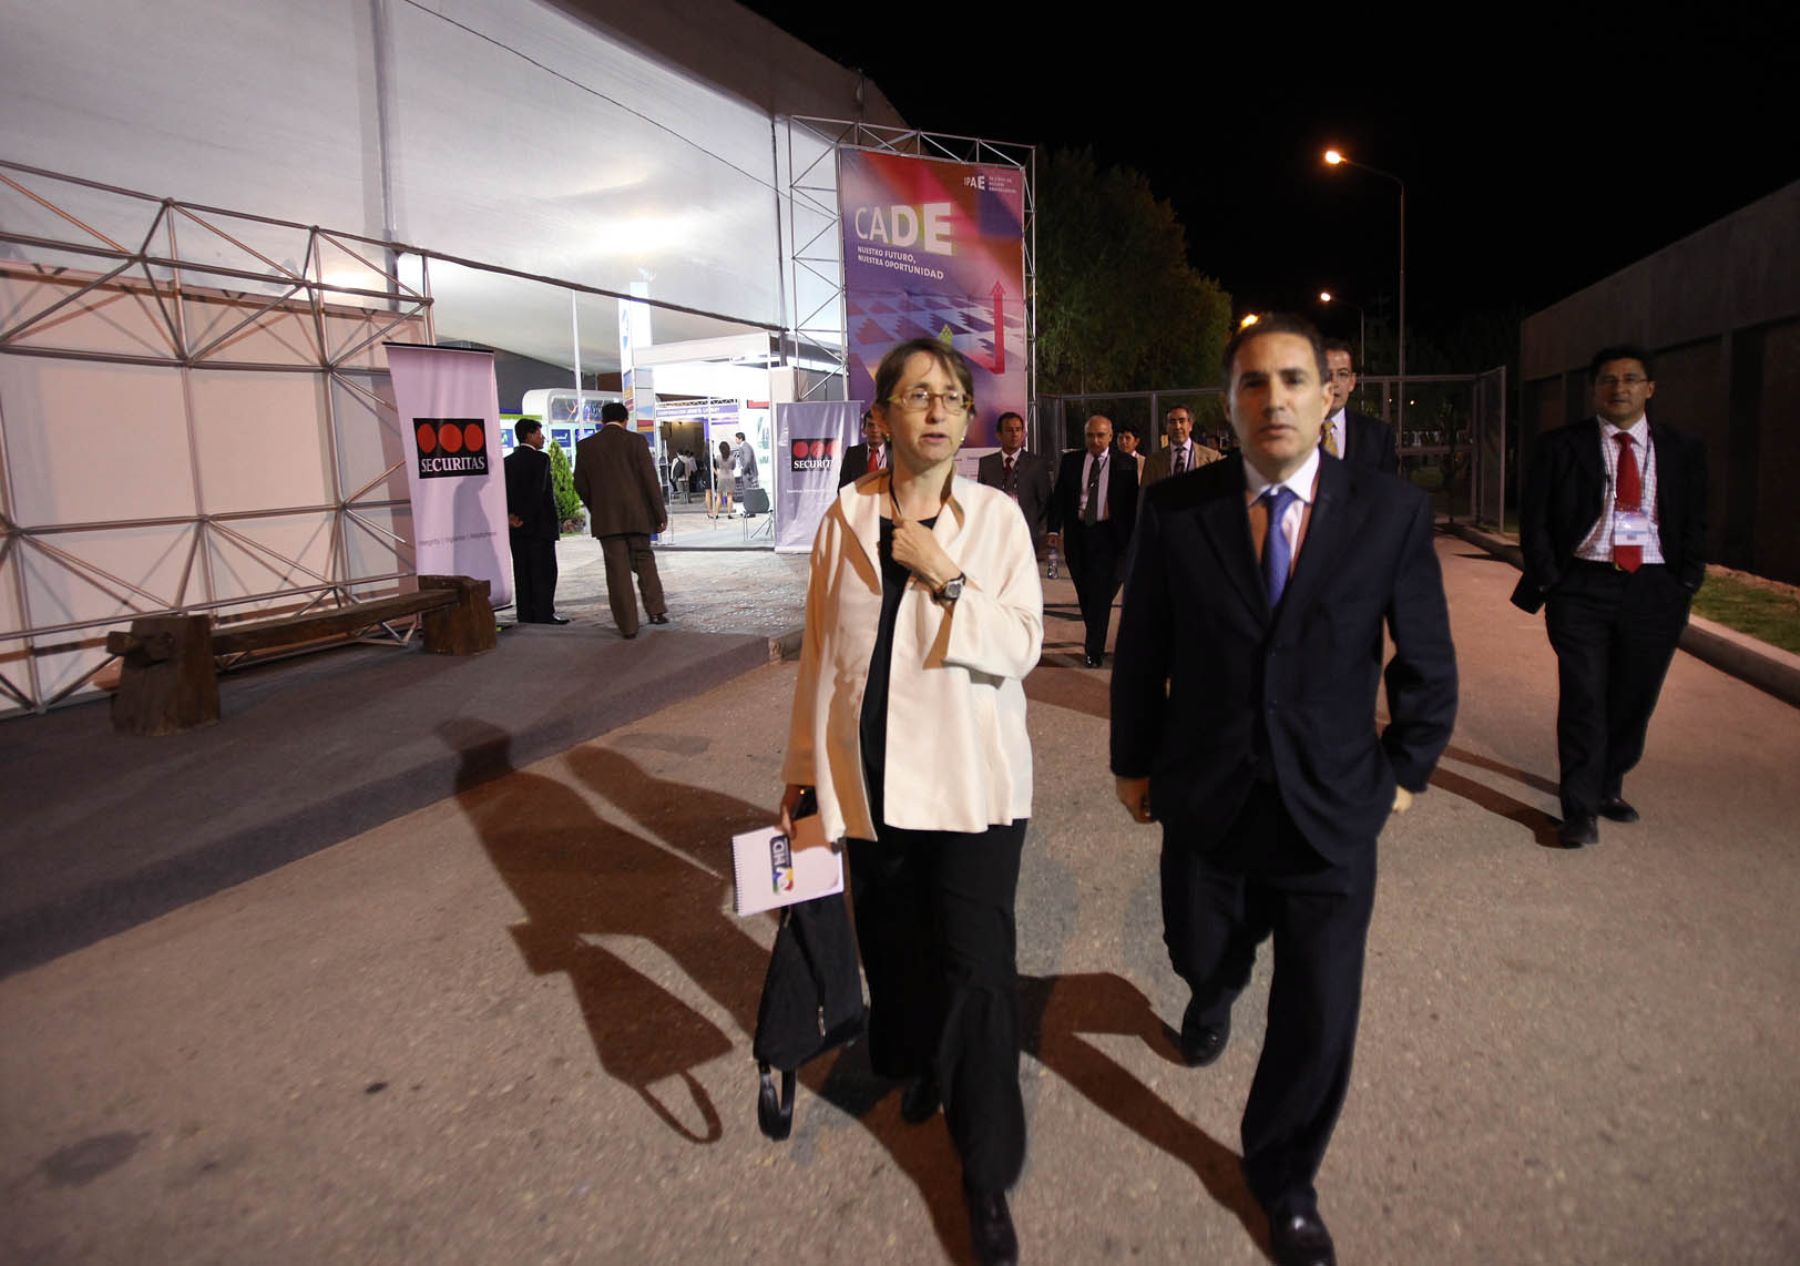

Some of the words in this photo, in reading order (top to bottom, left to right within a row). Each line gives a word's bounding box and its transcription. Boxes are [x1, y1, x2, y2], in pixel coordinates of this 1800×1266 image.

[963, 175, 985, 191] IPAE
[855, 202, 953, 256] CADE
[858, 245, 883, 257] NUESTRO
[884, 250, 916, 264] FUTURO,
[858, 254, 884, 266] NUESTRA
[884, 260, 944, 279] OPORTUNIDAD
[421, 456, 485, 472] SECURITAS
